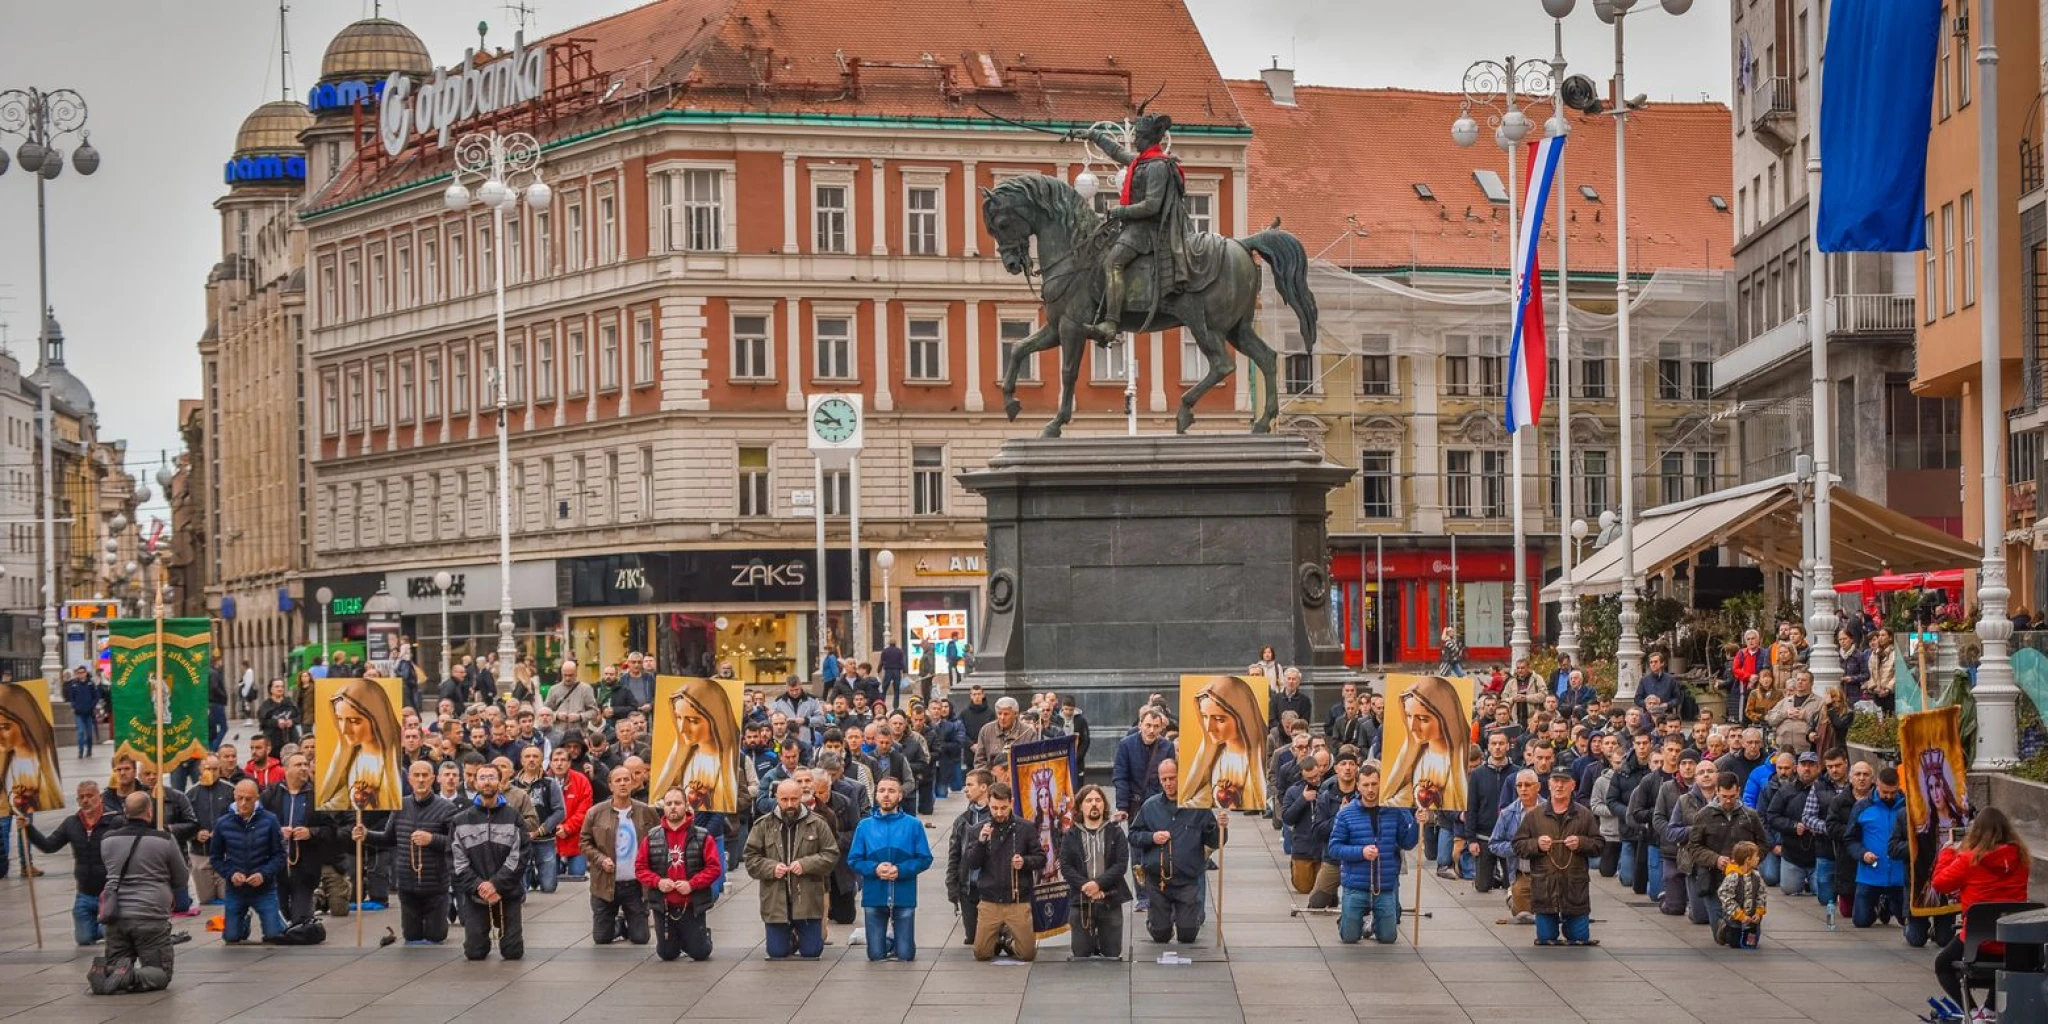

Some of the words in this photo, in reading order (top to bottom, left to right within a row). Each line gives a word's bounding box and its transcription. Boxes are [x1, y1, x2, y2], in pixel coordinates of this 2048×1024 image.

[415, 30, 545, 148] otpbanka
[614, 567, 645, 589] ZAKS
[731, 564, 805, 586] ZAKS
